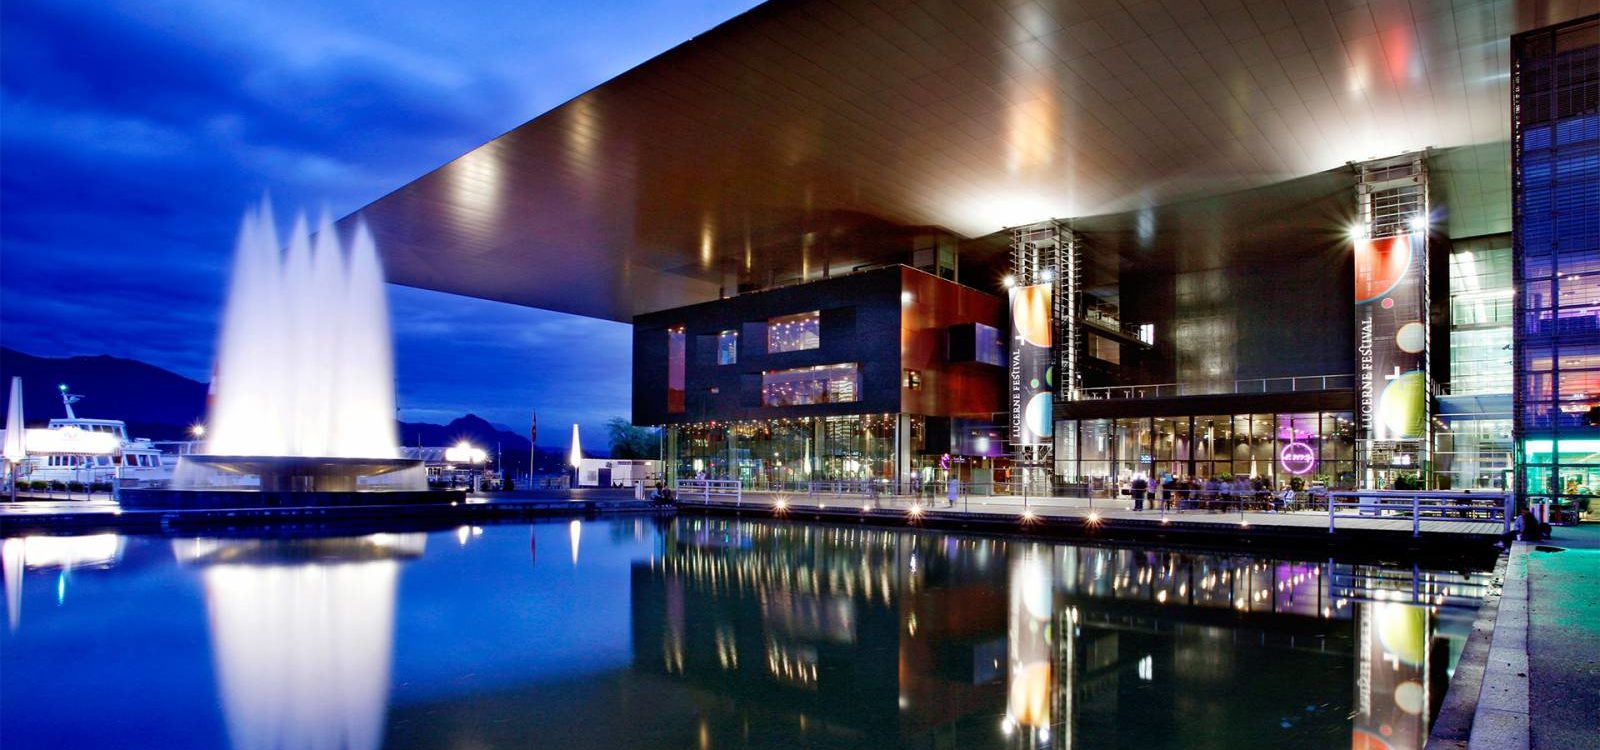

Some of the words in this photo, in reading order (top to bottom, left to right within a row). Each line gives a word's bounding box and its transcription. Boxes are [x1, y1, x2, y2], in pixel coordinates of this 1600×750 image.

[1359, 317, 1373, 370] FESTIVAL
[1011, 349, 1021, 391] FESTIVAL
[1012, 393, 1021, 438] LUCERNE
[1361, 373, 1373, 429] LUCERNE
